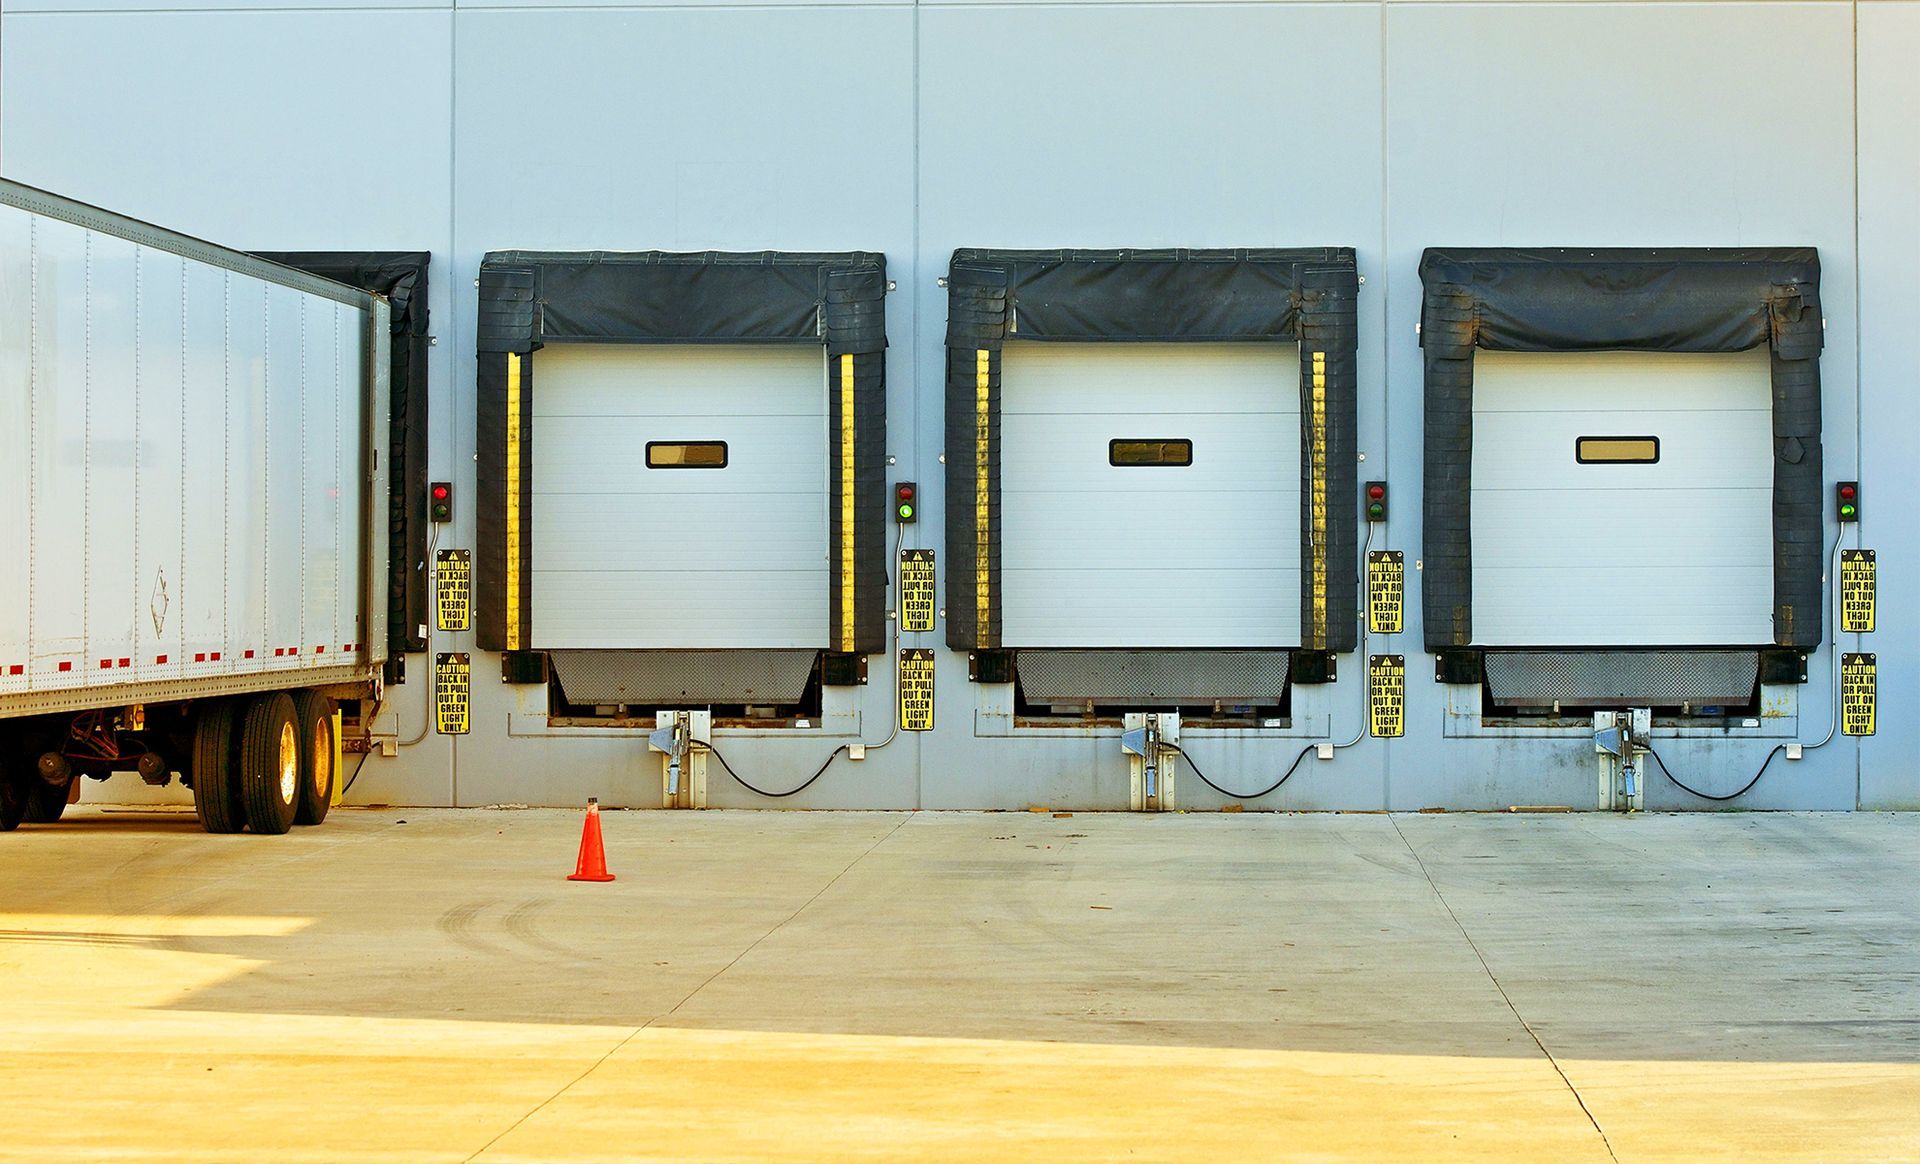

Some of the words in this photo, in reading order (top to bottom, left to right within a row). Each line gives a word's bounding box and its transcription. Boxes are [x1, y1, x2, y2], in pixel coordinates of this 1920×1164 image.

[437, 664, 469, 674] CAUTION
[901, 661, 933, 670] CAUTION
[1843, 665, 1875, 674] CAUTION
[903, 671, 922, 679] BACK
[924, 671, 931, 679] IN
[1371, 667, 1403, 676] CAUTION
[439, 675, 458, 683] BACK
[460, 675, 467, 683] IN
[1373, 677, 1392, 685] BACK
[1394, 677, 1401, 685] IN
[1844, 676, 1864, 684] BACK
[1866, 676, 1873, 684] IN
[914, 681, 932, 689] PULL
[1856, 686, 1874, 694] PULL
[439, 694, 454, 702] OUT
[457, 694, 467, 702] ON
[1845, 695, 1860, 703] OUT
[1863, 695, 1872, 703] ON
[441, 704, 465, 712] GREEN
[905, 701, 929, 709] GREEN
[1847, 705, 1871, 713] GREEN
[906, 710, 928, 718] LIGHT
[1375, 706, 1399, 714] GREEN
[442, 714, 464, 722] LIGHT
[1376, 716, 1398, 724] LIGHT
[1848, 715, 1870, 723] LIGHT
[445, 724, 462, 732] ONLY
[909, 720, 926, 728] ONLY
[1850, 724, 1868, 732] ONLY
[1379, 726, 1396, 734] ONLY
